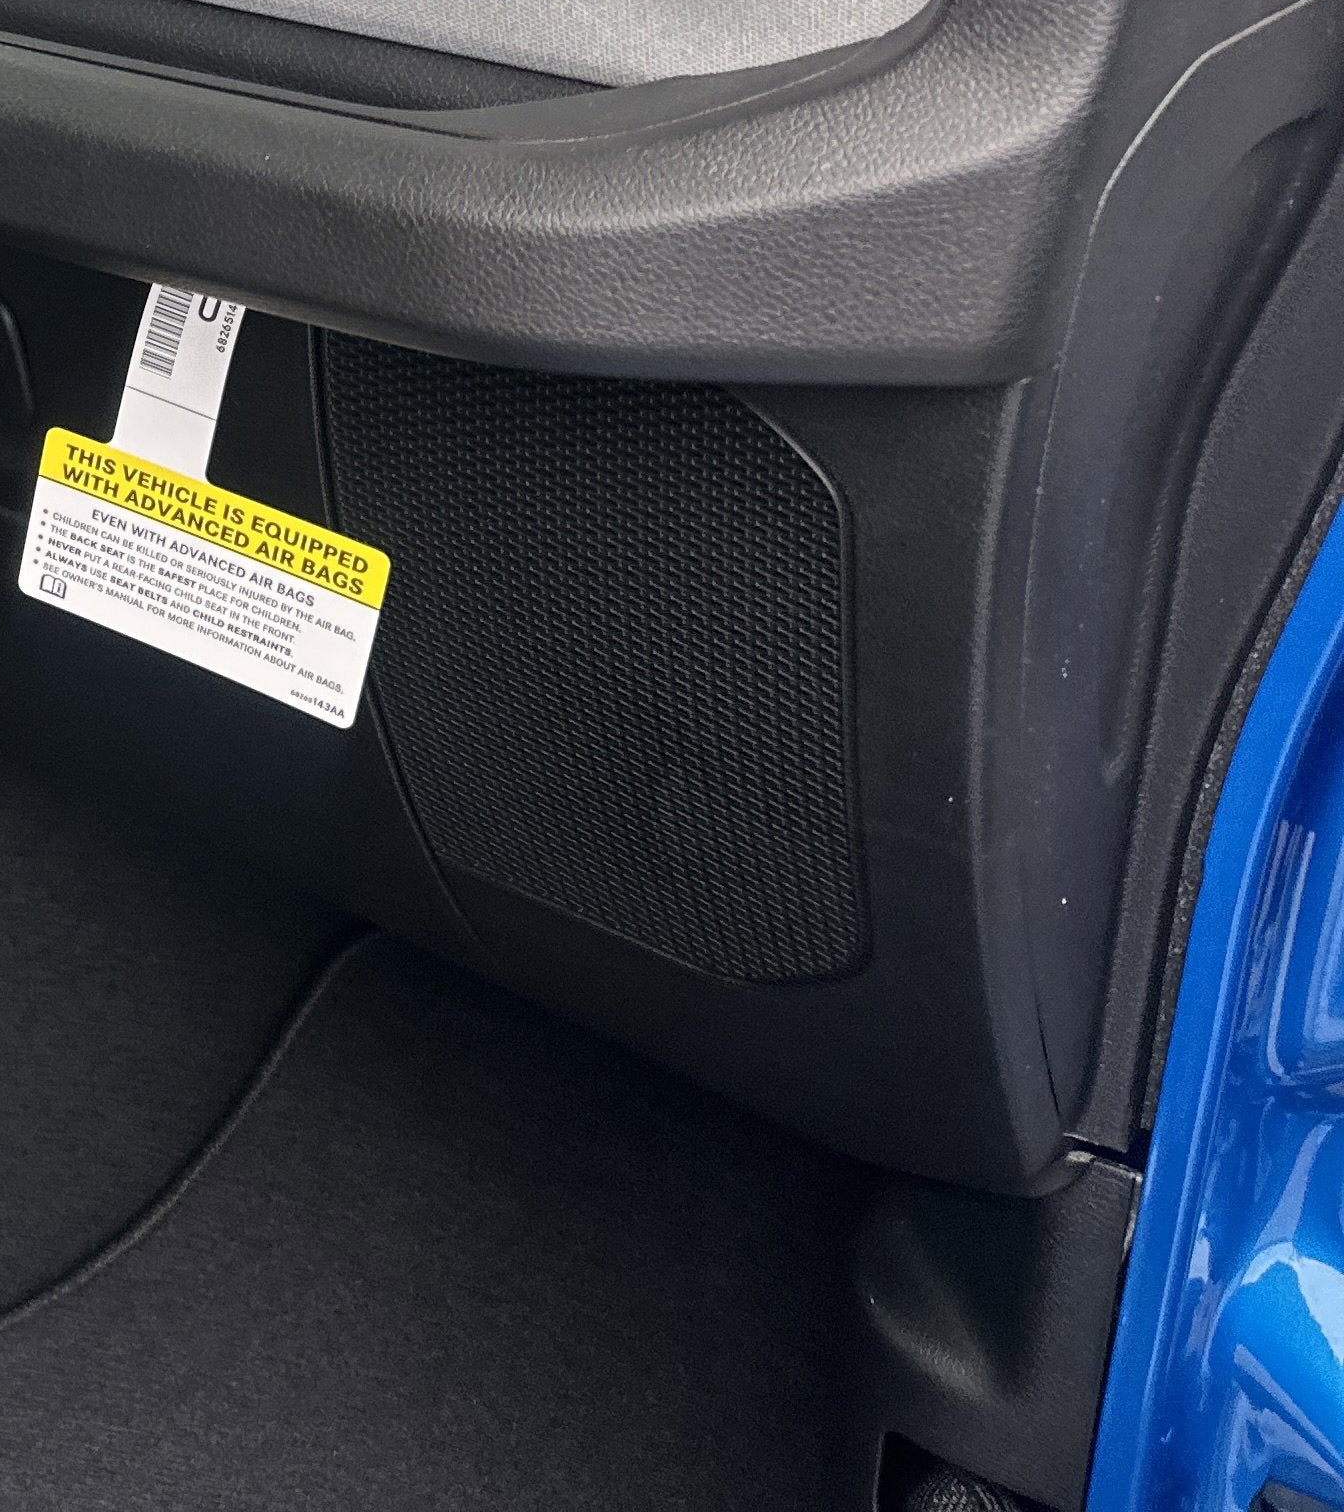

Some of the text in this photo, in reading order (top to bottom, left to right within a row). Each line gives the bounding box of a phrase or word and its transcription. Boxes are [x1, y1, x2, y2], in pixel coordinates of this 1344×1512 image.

[63, 463, 363, 595] WITH ADVANCED AIR BAGS
[66, 443, 368, 573] THIS VEHICLE IS EQUIPPED
[91, 509, 314, 606] EVEN WITH ADVANCED AIR BAGS
[42, 562, 59, 574] SEE
[105, 586, 143, 609] MANUAL
[146, 603, 165, 617] FOR
[167, 612, 194, 629] MORE
[196, 624, 261, 658] INFORMATION
[263, 653, 296, 672] ABOUT
[297, 667, 314, 680] AIR
[45, 550, 87, 572] ALWAYS
[89, 567, 107, 580] USE
[110, 575, 135, 591] SEAT
[170, 600, 190, 613] AND
[192, 609, 224, 627] CHILD
[227, 623, 294, 658] RESTRAINTS.
[51, 524, 67, 537] THE
[70, 532, 97, 549] BACK
[100, 544, 125, 559] SEAT
[127, 554, 135, 564] IS
[139, 558, 155, 572] THE
[158, 567, 196, 588] SAFEST
[198, 583, 227, 602] PLACE
[230, 596, 248, 610] FOR
[52, 512, 98, 536] CHILDREN
[100, 530, 119, 544] CAN
[136, 544, 168, 563] KILLED
[170, 558, 183, 569] OR
[186, 564, 237, 590] SERIOUSLY
[238, 586, 278, 608] INJURED
[280, 603, 293, 613] BY
[295, 608, 314, 623] THE
[314, 618, 331, 631] AIR
[84, 551, 101, 563] PUT
[102, 559, 109, 567] A
[174, 587, 202, 604] CHILD
[204, 600, 228, 614] SEAT
[229, 610, 239, 620] IN
[243, 615, 260, 629] THE
